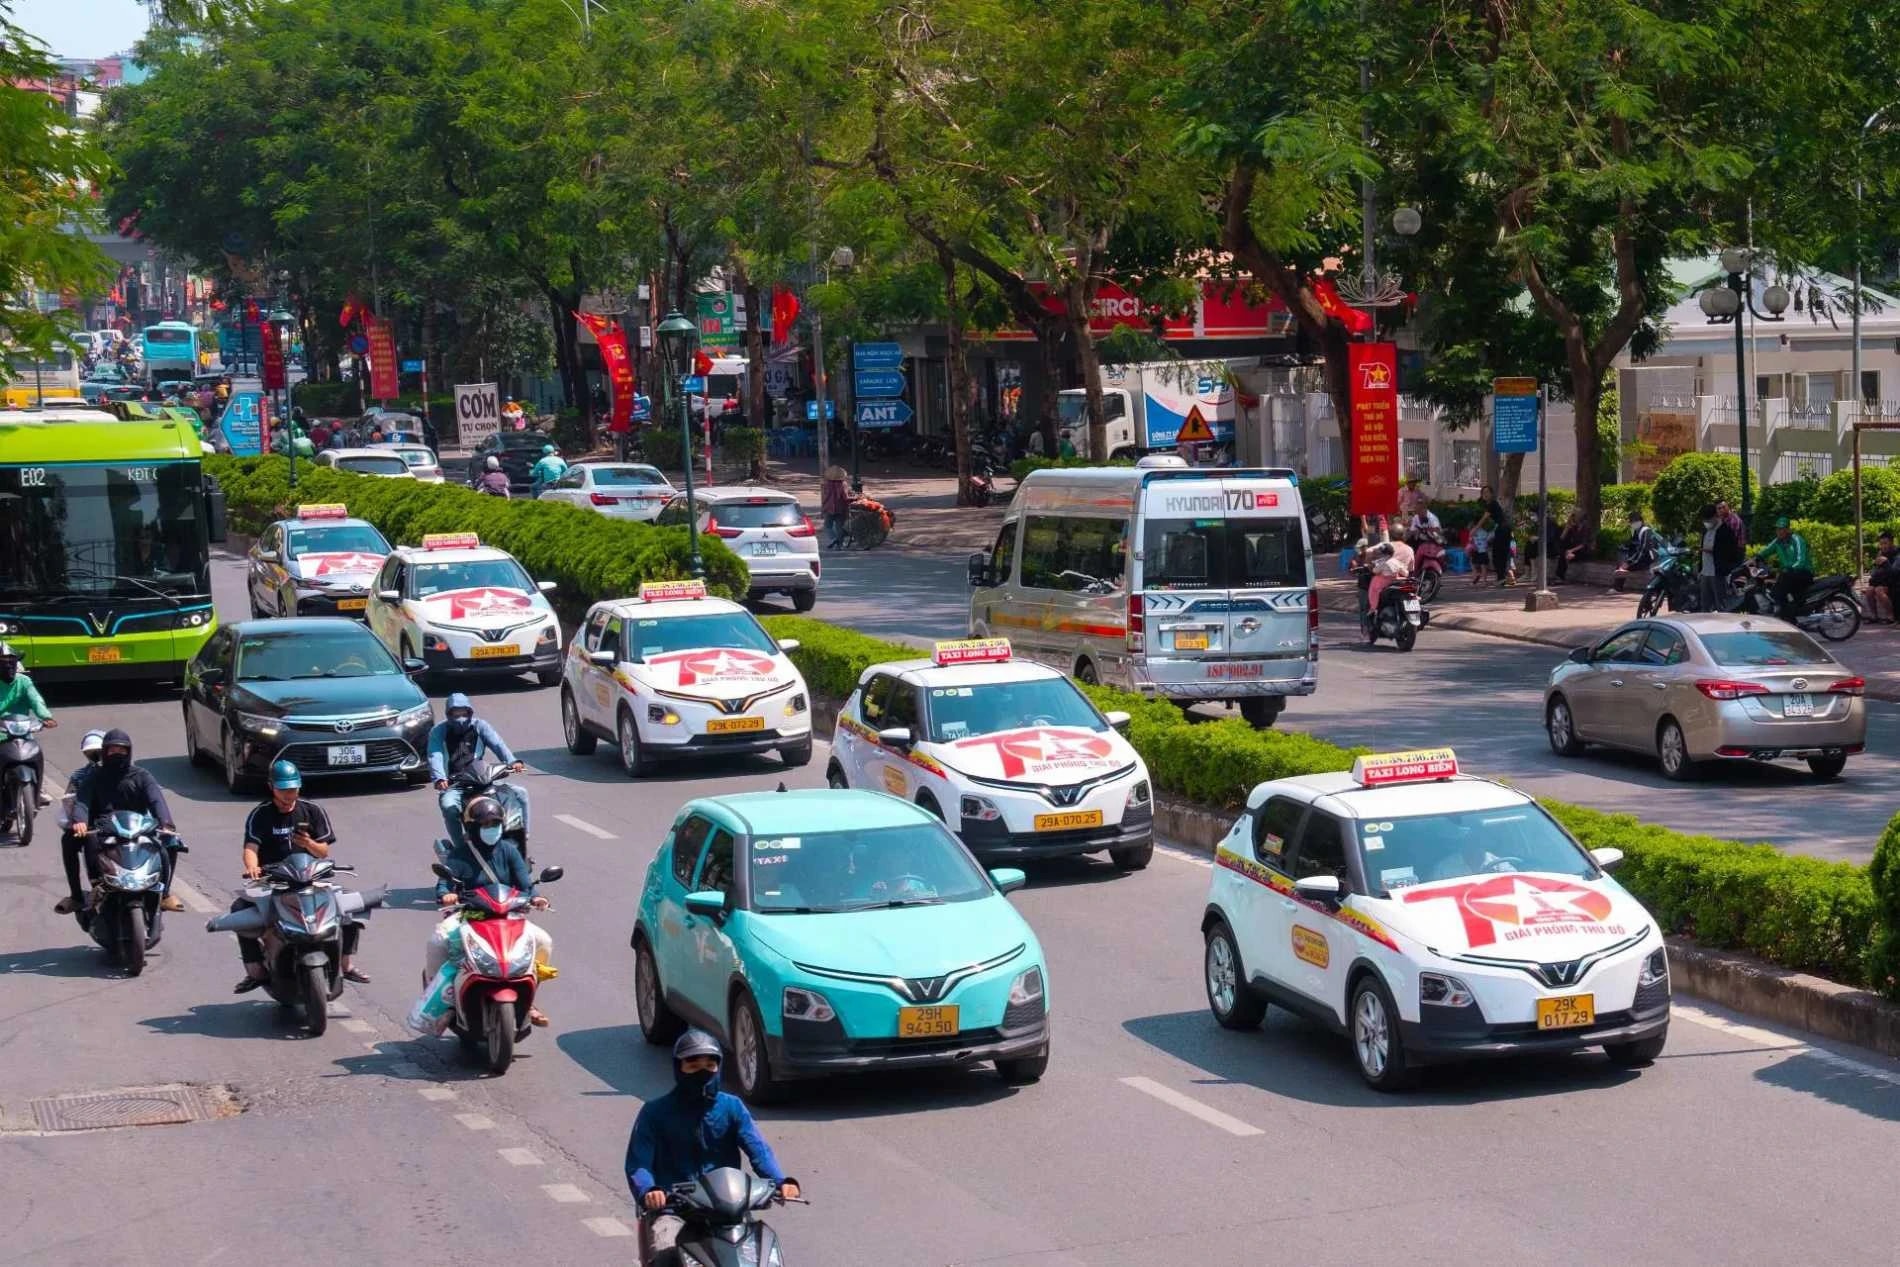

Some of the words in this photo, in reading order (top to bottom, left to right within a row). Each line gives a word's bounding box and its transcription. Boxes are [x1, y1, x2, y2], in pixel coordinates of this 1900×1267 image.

[861, 406, 897, 421] ANT
[20, 468, 46, 487] E02
[1166, 496, 1224, 512] HYUNDAI
[1224, 490, 1254, 511] 170
[940, 651, 961, 660] TAXI
[963, 649, 985, 657] LONG
[337, 746, 355, 755] 30G
[1367, 767, 1394, 779] TAXI
[1395, 765, 1425, 777] LONG
[1554, 996, 1577, 1012] 29K
[916, 1008, 942, 1021] 29H
[1544, 1011, 1588, 1027] 017.29
[906, 1021, 952, 1035] 943.50
